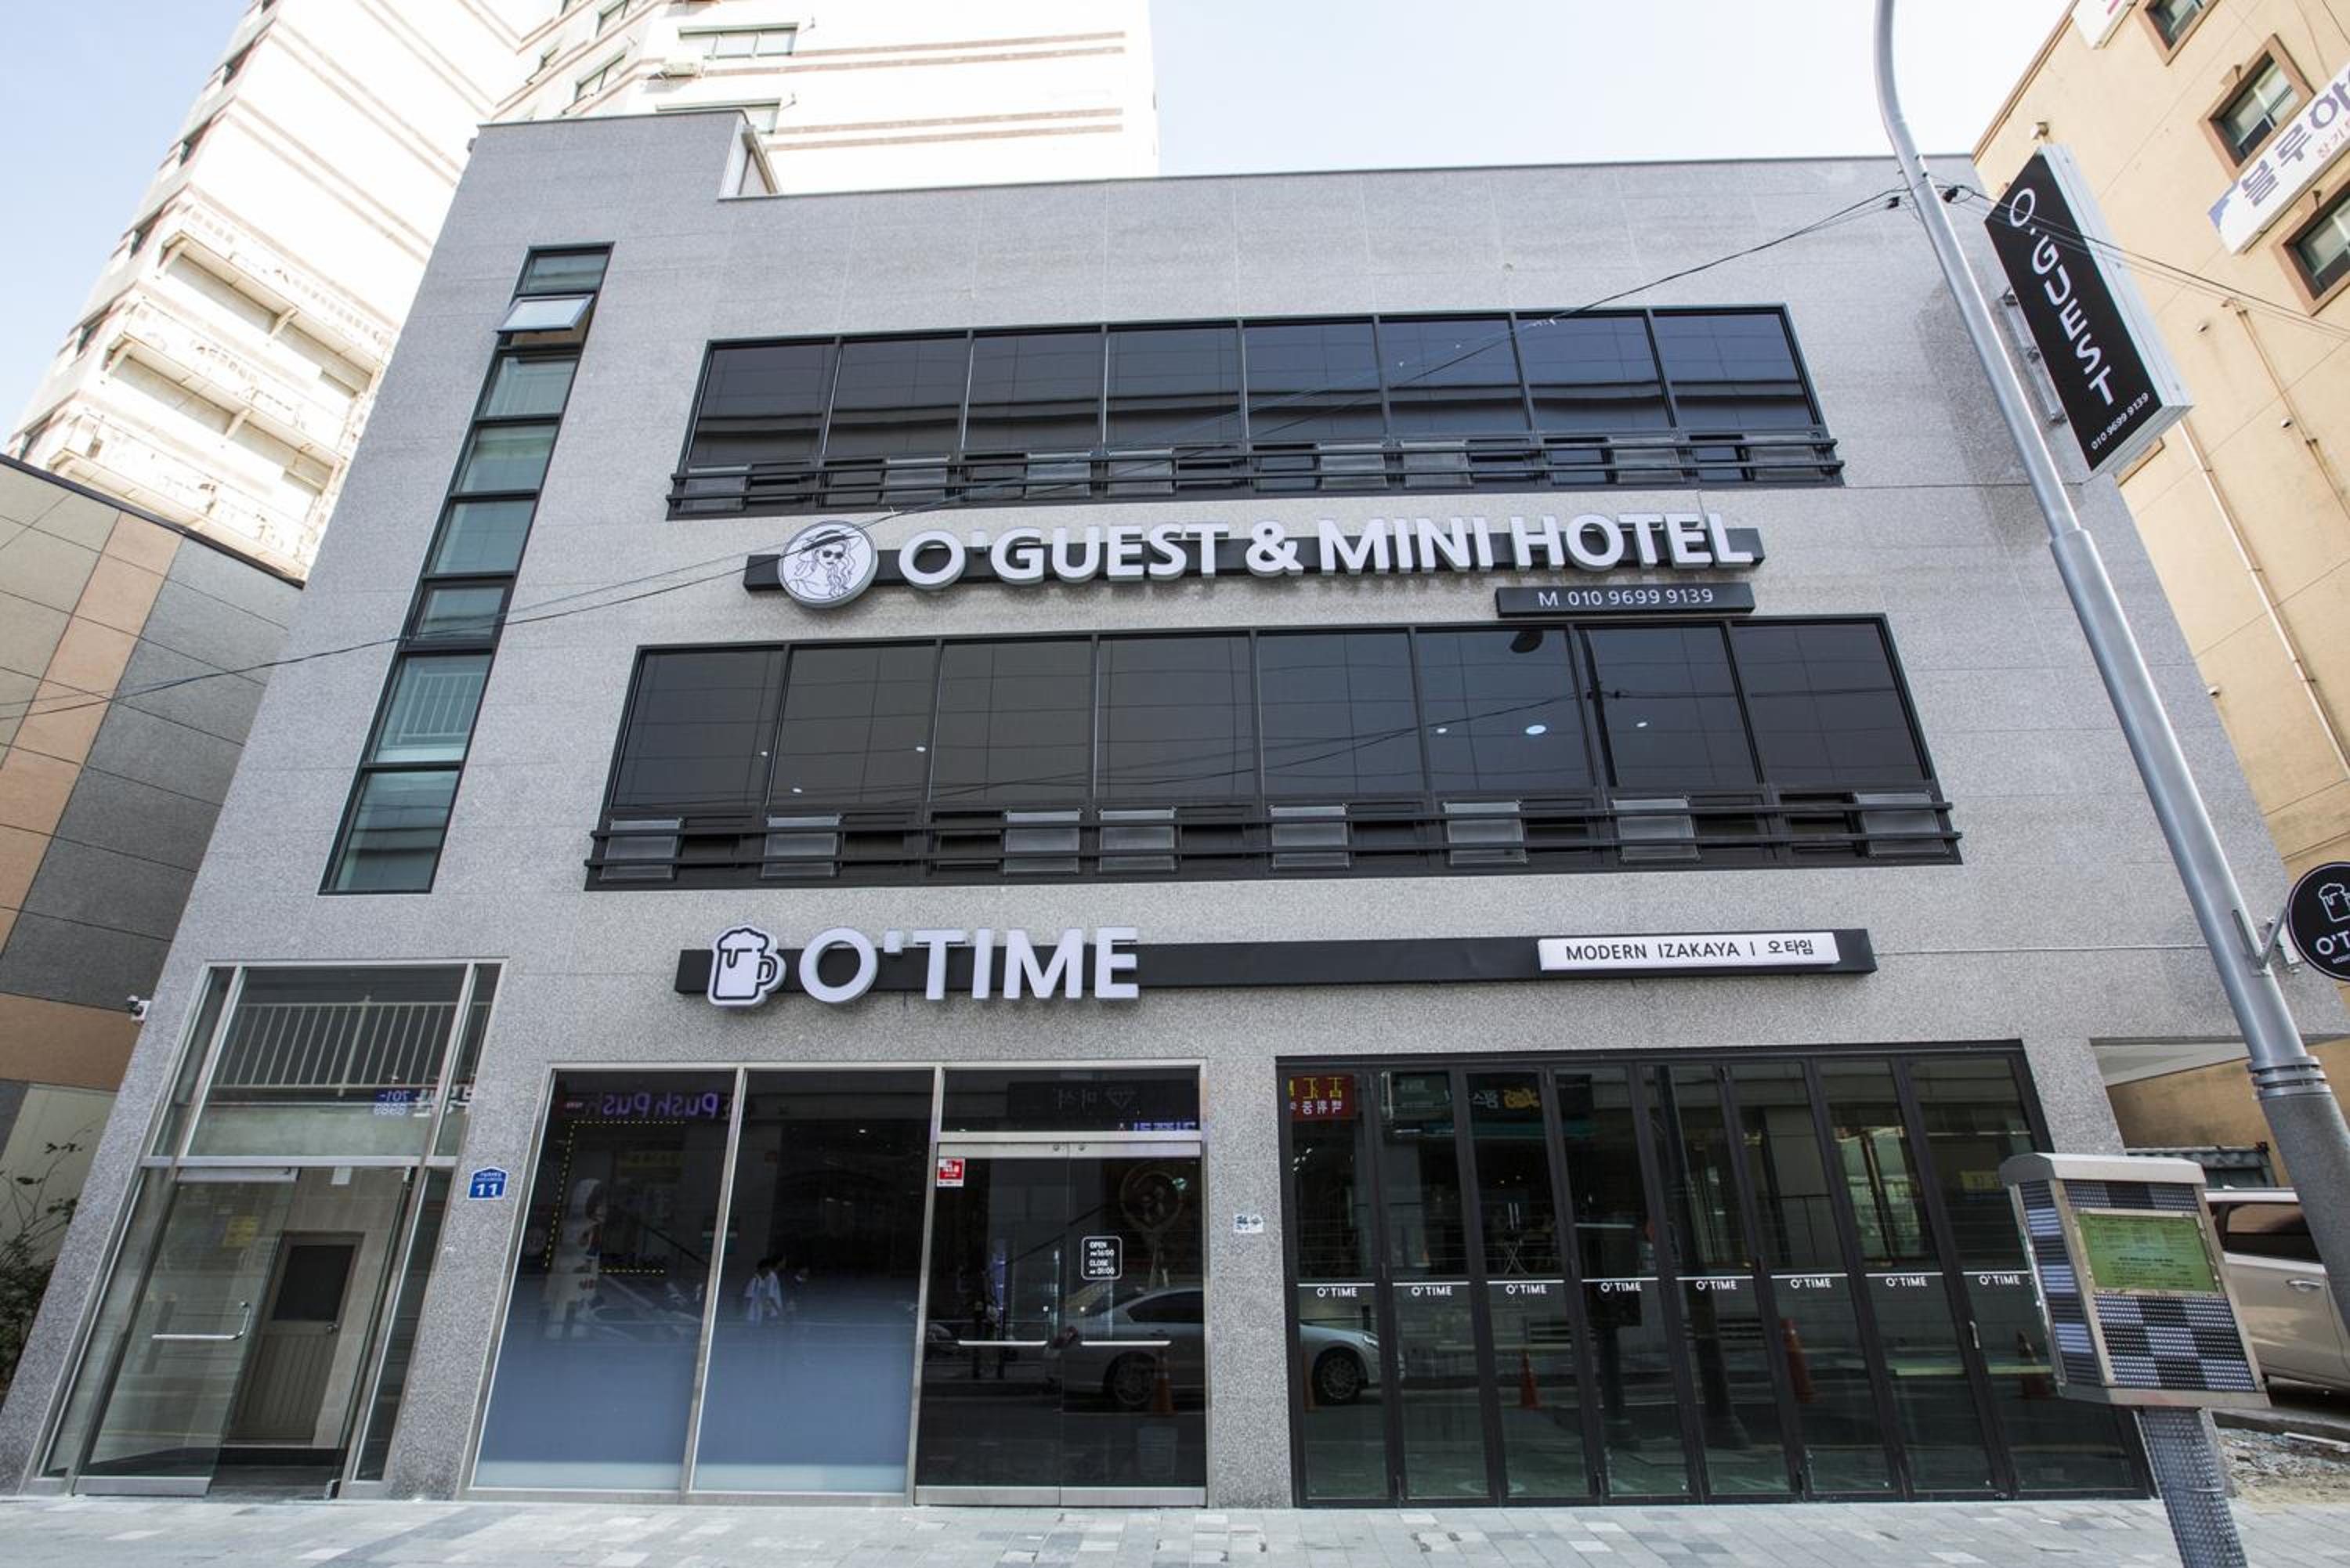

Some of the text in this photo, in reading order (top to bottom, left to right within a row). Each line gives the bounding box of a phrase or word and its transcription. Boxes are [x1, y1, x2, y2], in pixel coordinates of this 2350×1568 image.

[2241, 64, 2350, 207] 블루아
[2091, 432, 2107, 450] 010
[2106, 413, 2128, 435] 9699
[898, 512, 1753, 588] O'GUEST & MINI HOTEL
[1538, 588, 1713, 606] M 010 9699 9139
[1567, 941, 1741, 961] MODERN IZAKAYA
[1767, 939, 1814, 956] 오타임
[799, 926, 1139, 1003] O'TIME
[476, 1183, 497, 1195] 11
